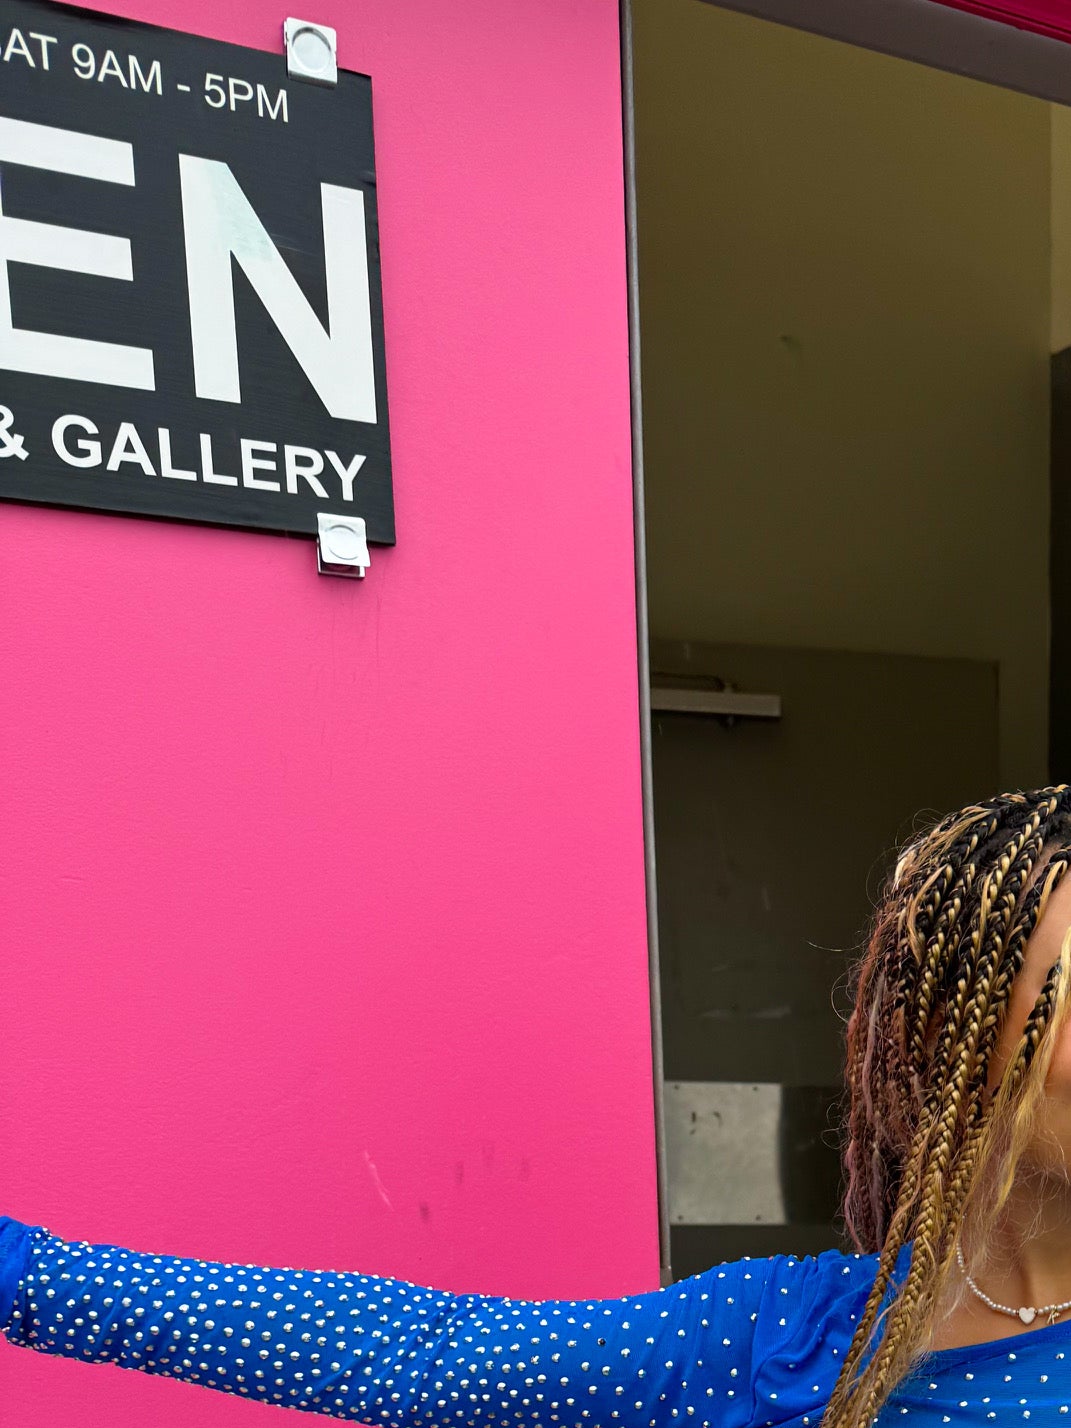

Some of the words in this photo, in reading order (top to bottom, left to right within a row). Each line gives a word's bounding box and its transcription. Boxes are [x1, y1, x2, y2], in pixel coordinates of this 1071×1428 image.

[0, 28, 58, 71] AT
[71, 43, 163, 95] 9AM
[176, 83, 191, 92] -
[204, 73, 289, 123] 5PM
[0, 117, 378, 424] EN
[0, 405, 30, 461] &
[51, 414, 367, 502] GALLERY
